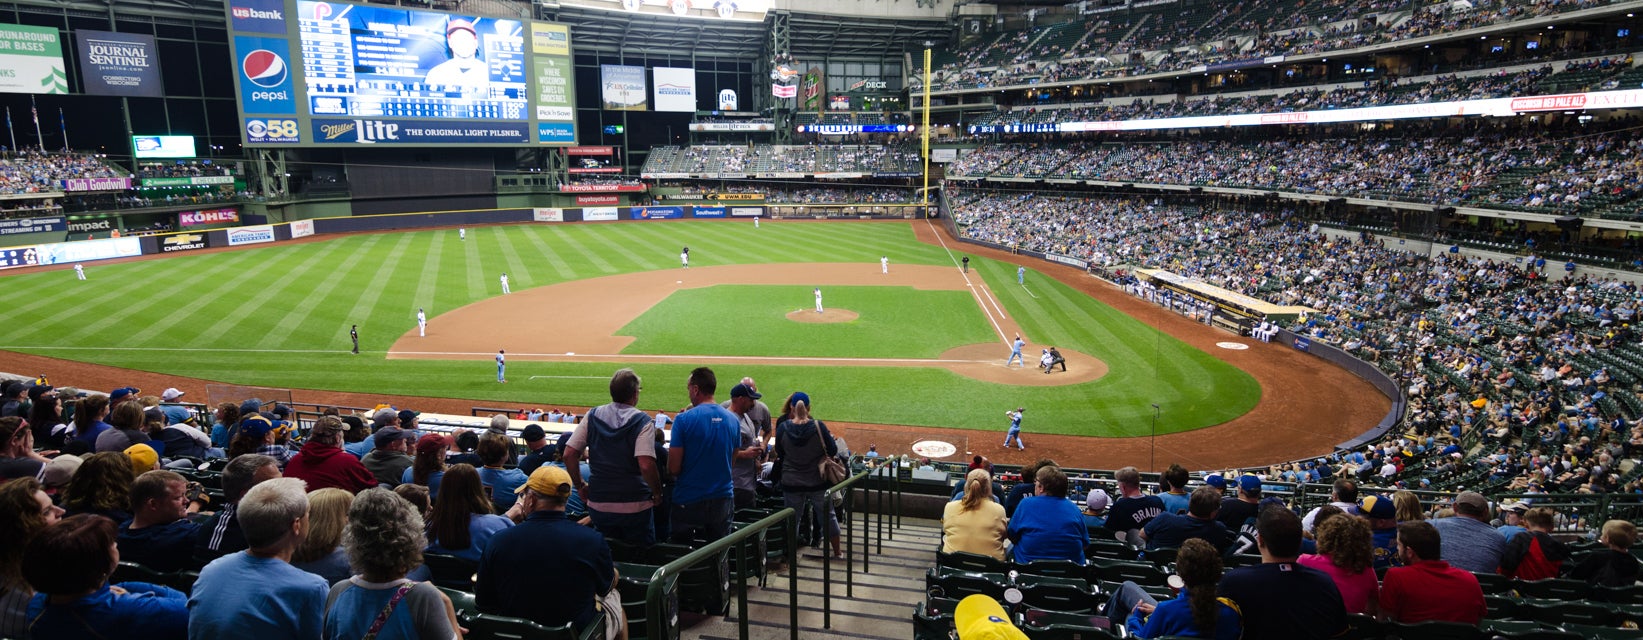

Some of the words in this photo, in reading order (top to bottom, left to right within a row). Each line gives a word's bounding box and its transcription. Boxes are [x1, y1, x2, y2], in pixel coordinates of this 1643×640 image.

[0, 30, 56, 43] RUNAROUND
[14, 41, 45, 52] BASES
[89, 45, 148, 58] JOURNAL
[90, 55, 149, 67] SENTINEL
[865, 81, 887, 89] DECK
[252, 91, 288, 102] pepsi
[1543, 98, 1555, 107] RED
[1555, 97, 1572, 107] PALE
[1572, 96, 1584, 106] ALE
[267, 119, 299, 138] 58
[320, 122, 355, 140] Miller
[353, 119, 400, 144] Lite
[405, 128, 423, 136] THE
[425, 128, 462, 136] ORIGINAL
[464, 129, 488, 137] LIGHT
[68, 179, 88, 191] Club
[90, 178, 127, 190] Goodwill
[181, 211, 237, 223] KOHL'S
[0, 226, 33, 234] STREAMING
[67, 220, 111, 232] impact
[164, 242, 205, 252] CHEVROLET
[1233, 534, 1254, 555] 7
